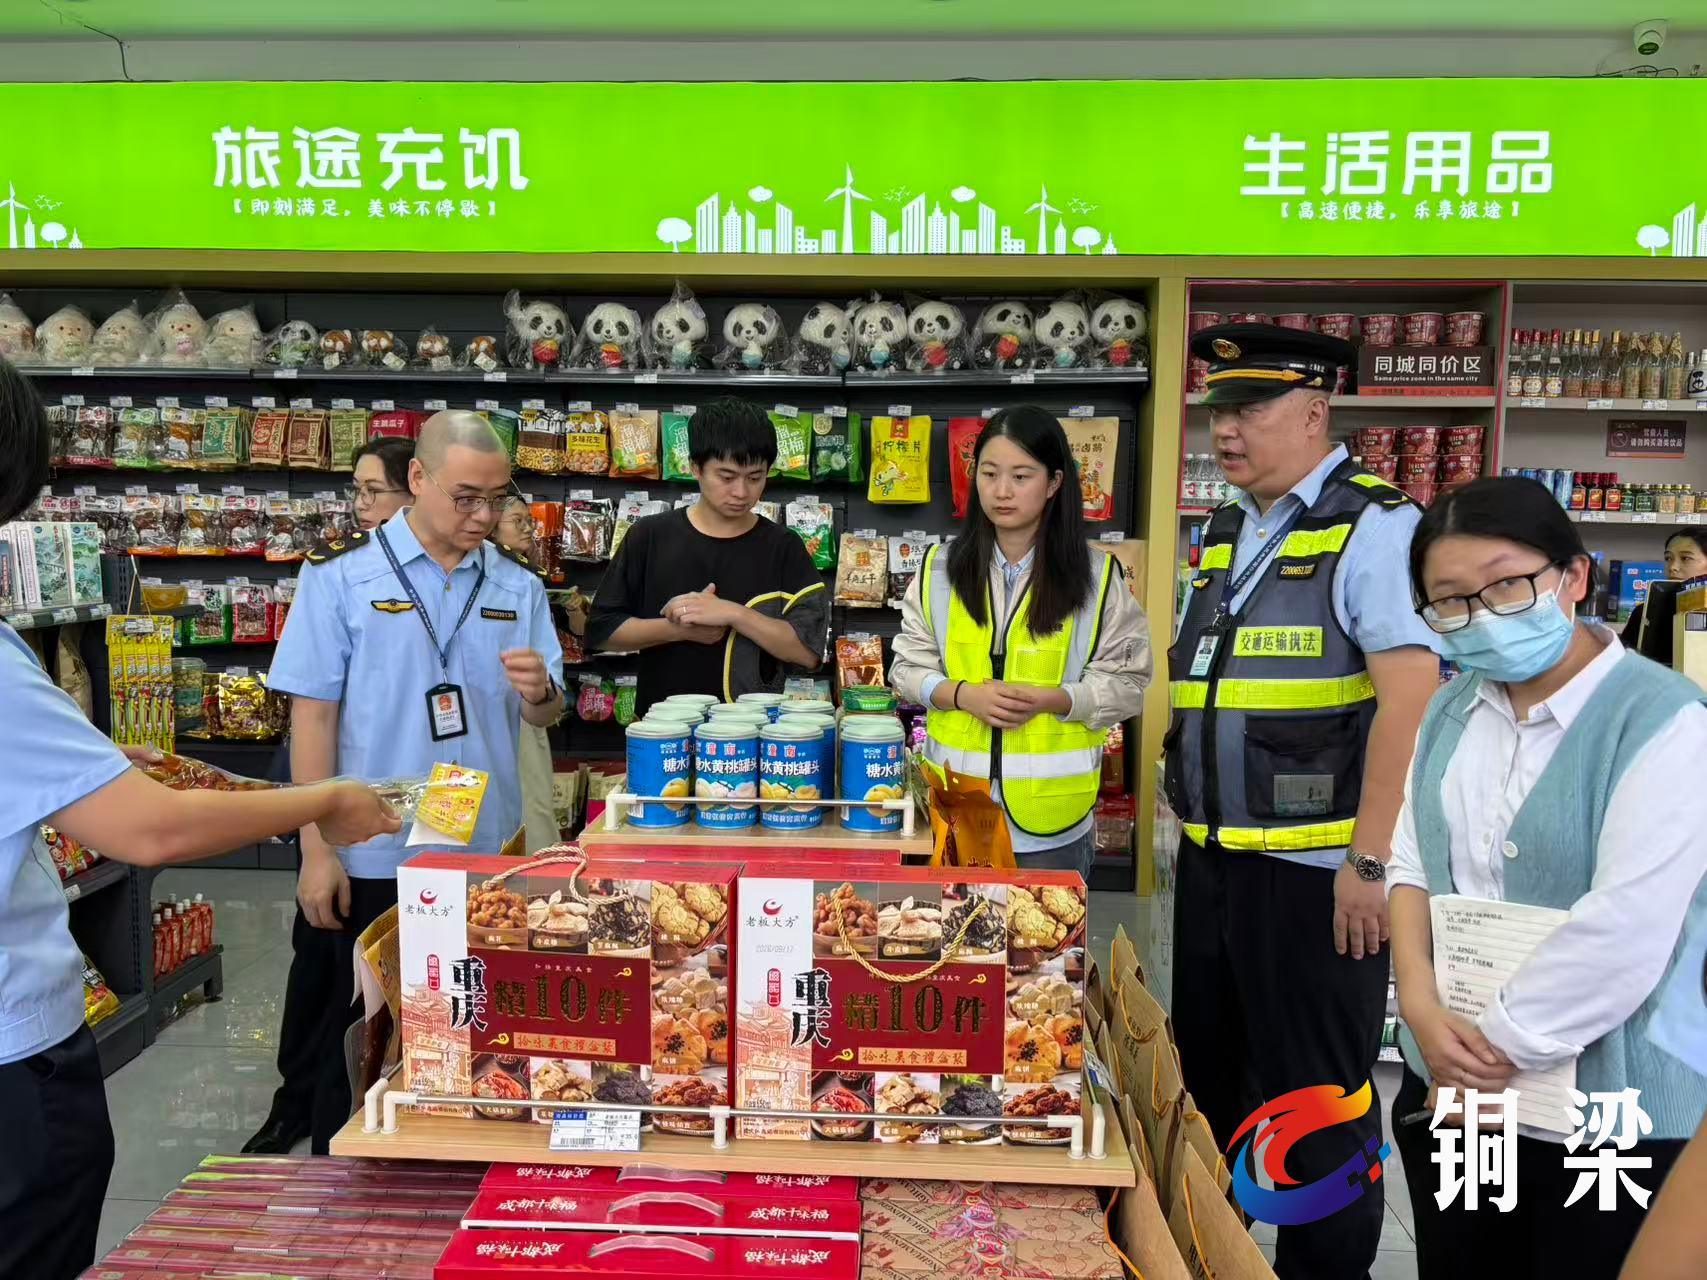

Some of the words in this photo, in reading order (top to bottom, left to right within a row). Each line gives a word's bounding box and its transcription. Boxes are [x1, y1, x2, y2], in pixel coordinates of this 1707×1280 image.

[212, 126, 529, 191] 旅途充饥
[1240, 130, 1552, 197] 生活用品
[1374, 355, 1480, 374] 同城同价区
[1241, 631, 1316, 651] 交通运输执法
[760, 758, 820, 777] 水黄桃罐头
[405, 903, 450, 918] 老板大方
[746, 914, 796, 928] 老板大方
[449, 954, 487, 1032] 重庆
[791, 967, 832, 1048] 重庆
[748, 1207, 830, 1220] 成都十味福
